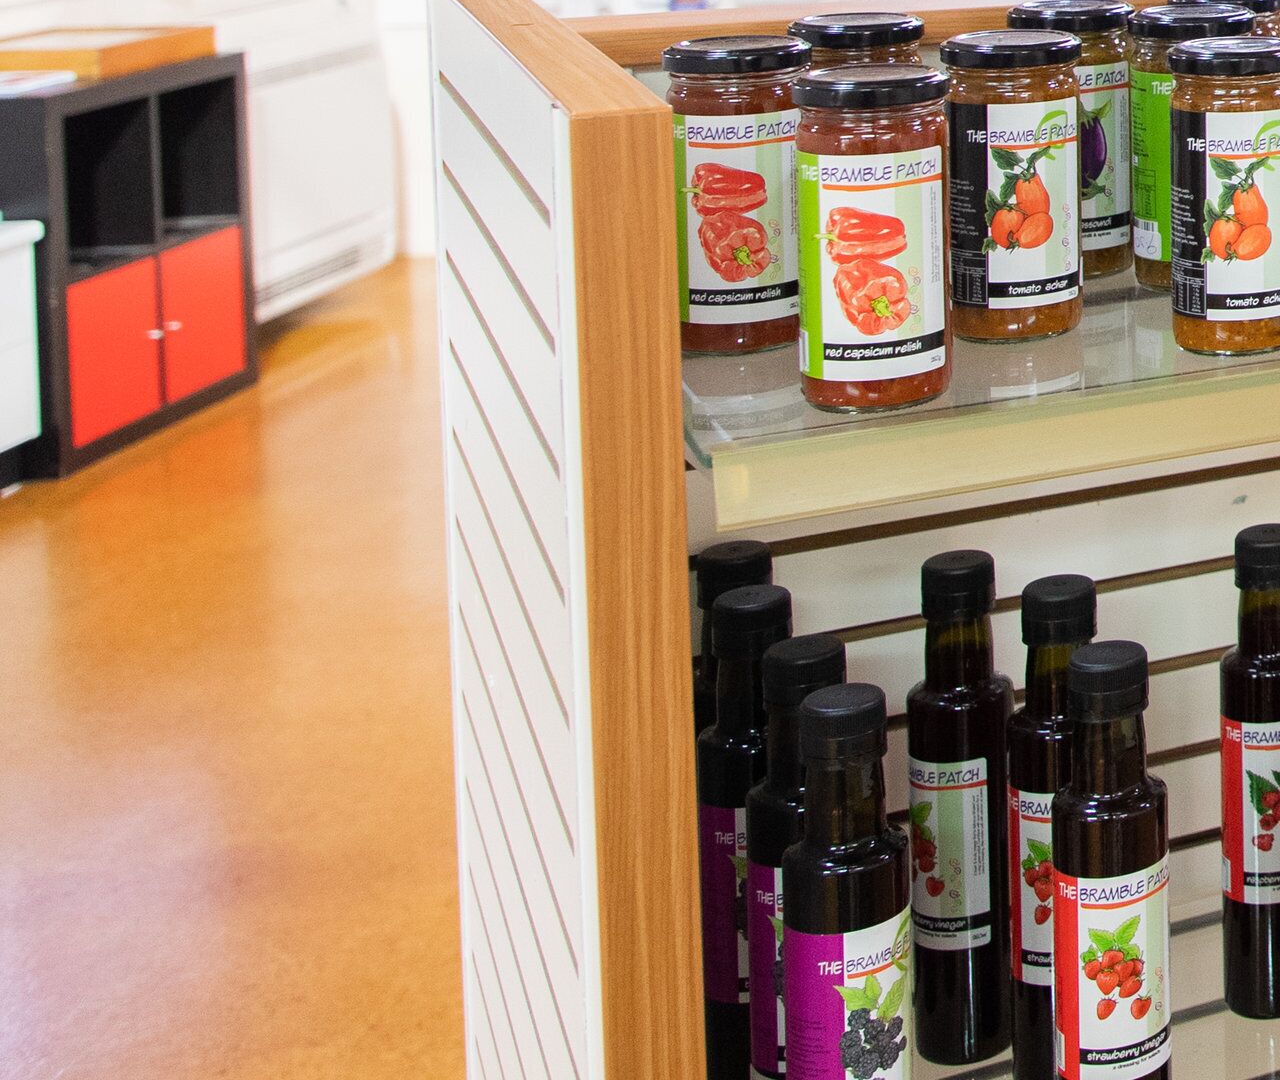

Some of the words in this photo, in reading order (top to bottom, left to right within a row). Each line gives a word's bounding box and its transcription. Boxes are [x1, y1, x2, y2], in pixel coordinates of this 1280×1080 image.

[1095, 70, 1126, 86] PATCH
[1152, 81, 1172, 95] THE
[687, 123, 754, 141] BRAMBLE
[757, 119, 796, 138] PATCH
[966, 130, 987, 143] THE
[990, 129, 1048, 143] BRAMBLE
[1187, 138, 1205, 151] THE
[1208, 138, 1267, 152] BRAMBLE
[801, 164, 819, 181] THE
[821, 166, 892, 183] BRAMBLE
[896, 159, 937, 178] PATCH
[1008, 283, 1042, 295] tomato
[1045, 278, 1068, 292] achar
[691, 290, 705, 302] red
[708, 291, 754, 304] capsicum
[756, 286, 781, 300] relish
[1226, 296, 1260, 308] tomato
[826, 347, 842, 358] red
[844, 345, 893, 359] capsicum
[895, 340, 922, 355] relish
[1226, 726, 1241, 742] THE
[938, 768, 980, 784] PATCH
[714, 831, 734, 845] THE
[756, 890, 774, 904] THE
[1059, 881, 1077, 900] THE
[1079, 882, 1145, 904] BRAMBLE
[818, 961, 844, 976] THE
[1087, 1046, 1140, 1062] strawberry
[1141, 1031, 1166, 1052] vinegar
